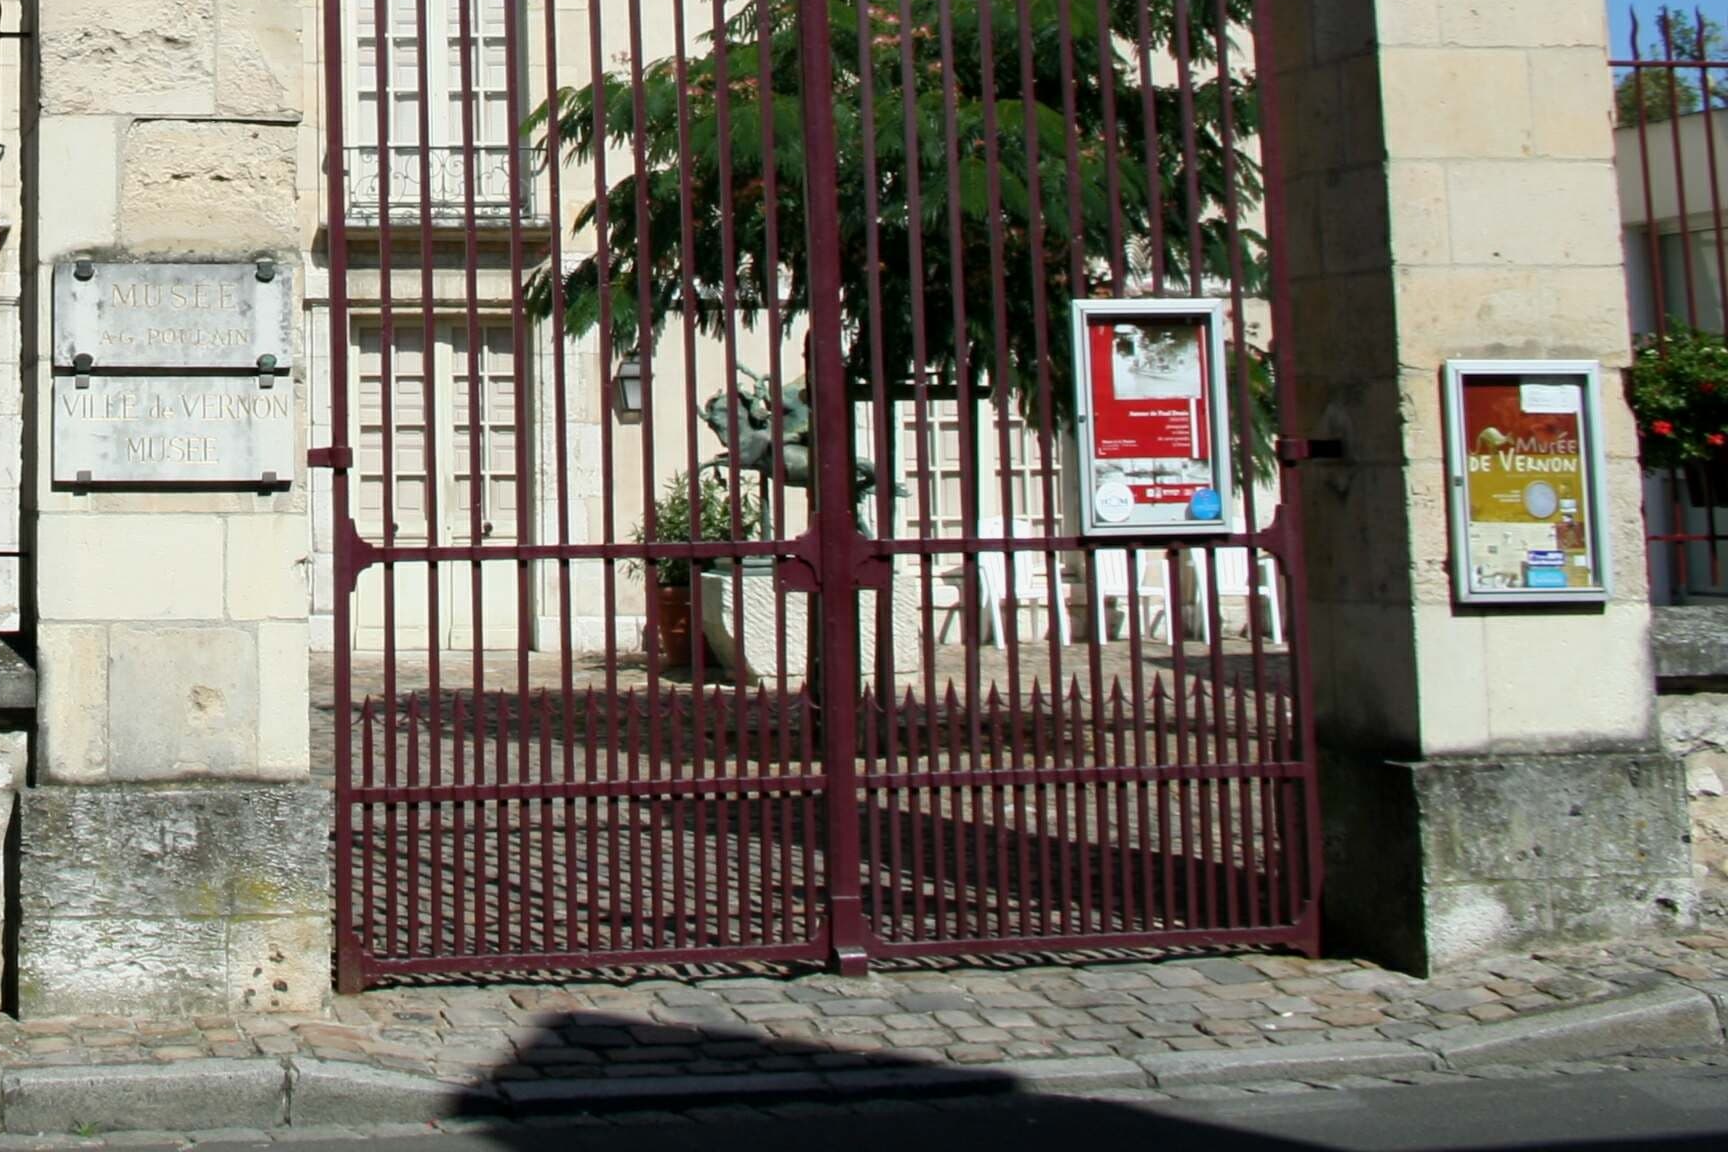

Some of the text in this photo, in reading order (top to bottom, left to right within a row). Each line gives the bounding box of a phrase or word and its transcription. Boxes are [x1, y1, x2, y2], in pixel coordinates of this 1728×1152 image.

[111, 283, 238, 310] MUSEE
[147, 328, 250, 346] POULAIN
[61, 393, 289, 421] VILLE de VERNON
[127, 437, 219, 464] MUSEE
[1468, 447, 1578, 473] DE VERNON
